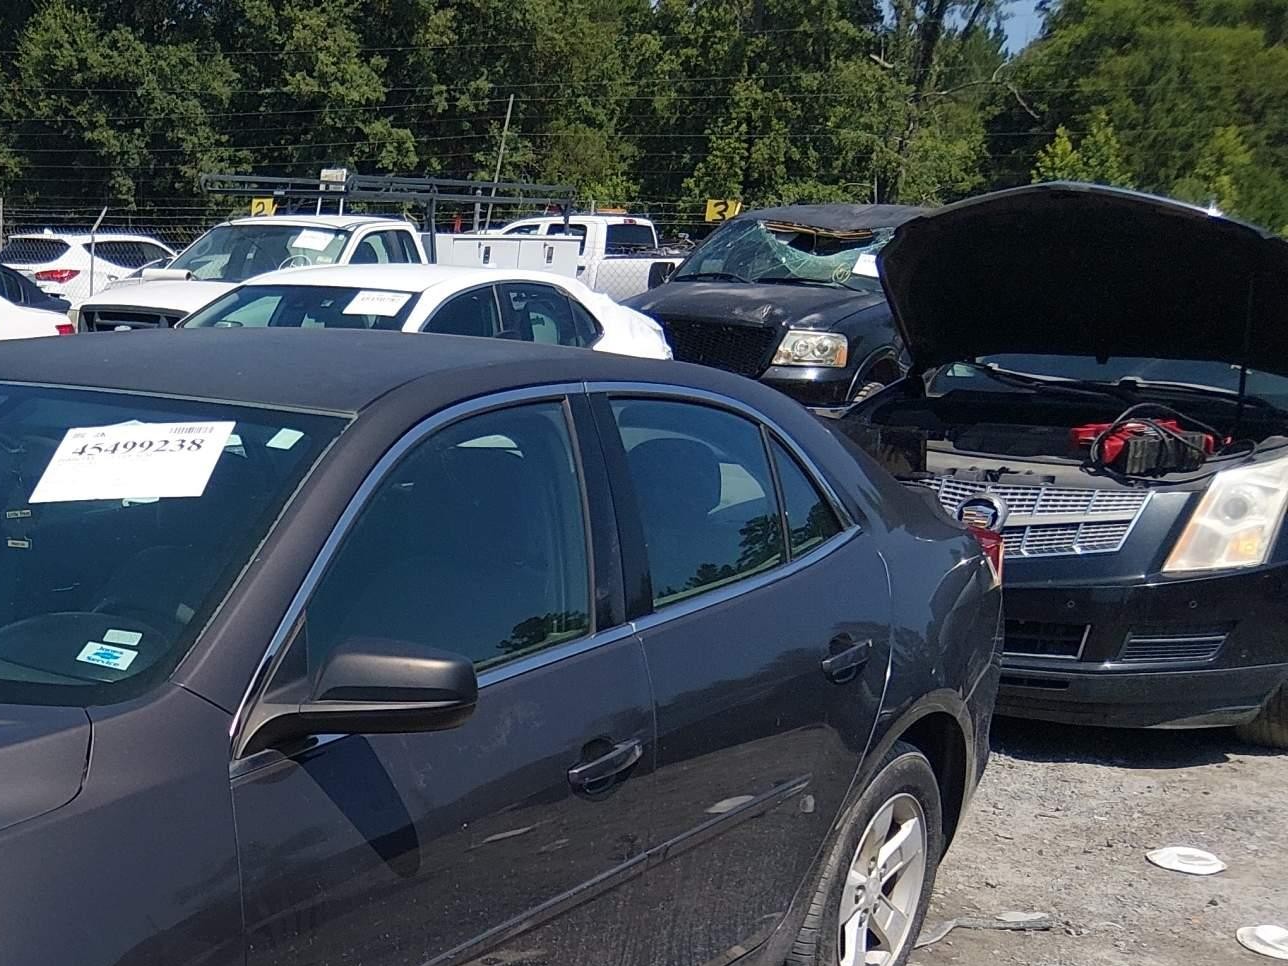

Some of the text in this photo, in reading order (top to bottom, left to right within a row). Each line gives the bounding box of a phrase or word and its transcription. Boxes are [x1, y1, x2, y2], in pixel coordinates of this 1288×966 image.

[255, 202, 270, 216] 2
[712, 202, 729, 222] 3
[72, 438, 205, 455] 45499238
